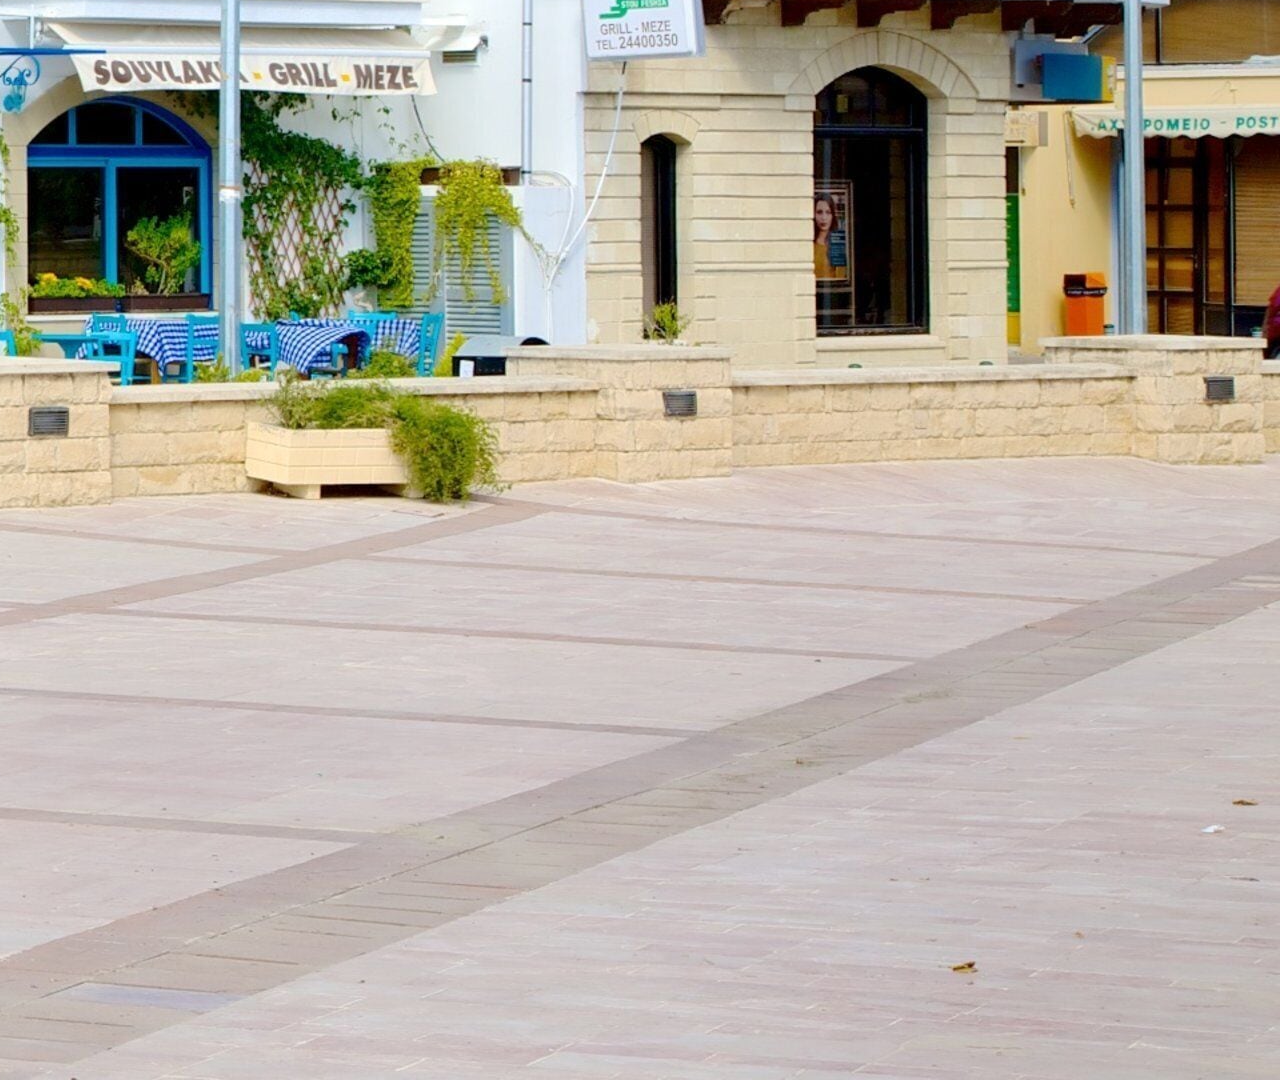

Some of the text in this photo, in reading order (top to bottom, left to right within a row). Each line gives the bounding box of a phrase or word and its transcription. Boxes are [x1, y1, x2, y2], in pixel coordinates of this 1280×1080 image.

[600, 23, 633, 36] GRILL
[641, 20, 672, 33] MEZE
[619, 33, 678, 49] 24400350
[268, 62, 338, 88] GRILL
[352, 63, 419, 90] MEZE
[1235, 116, 1279, 129] POST
